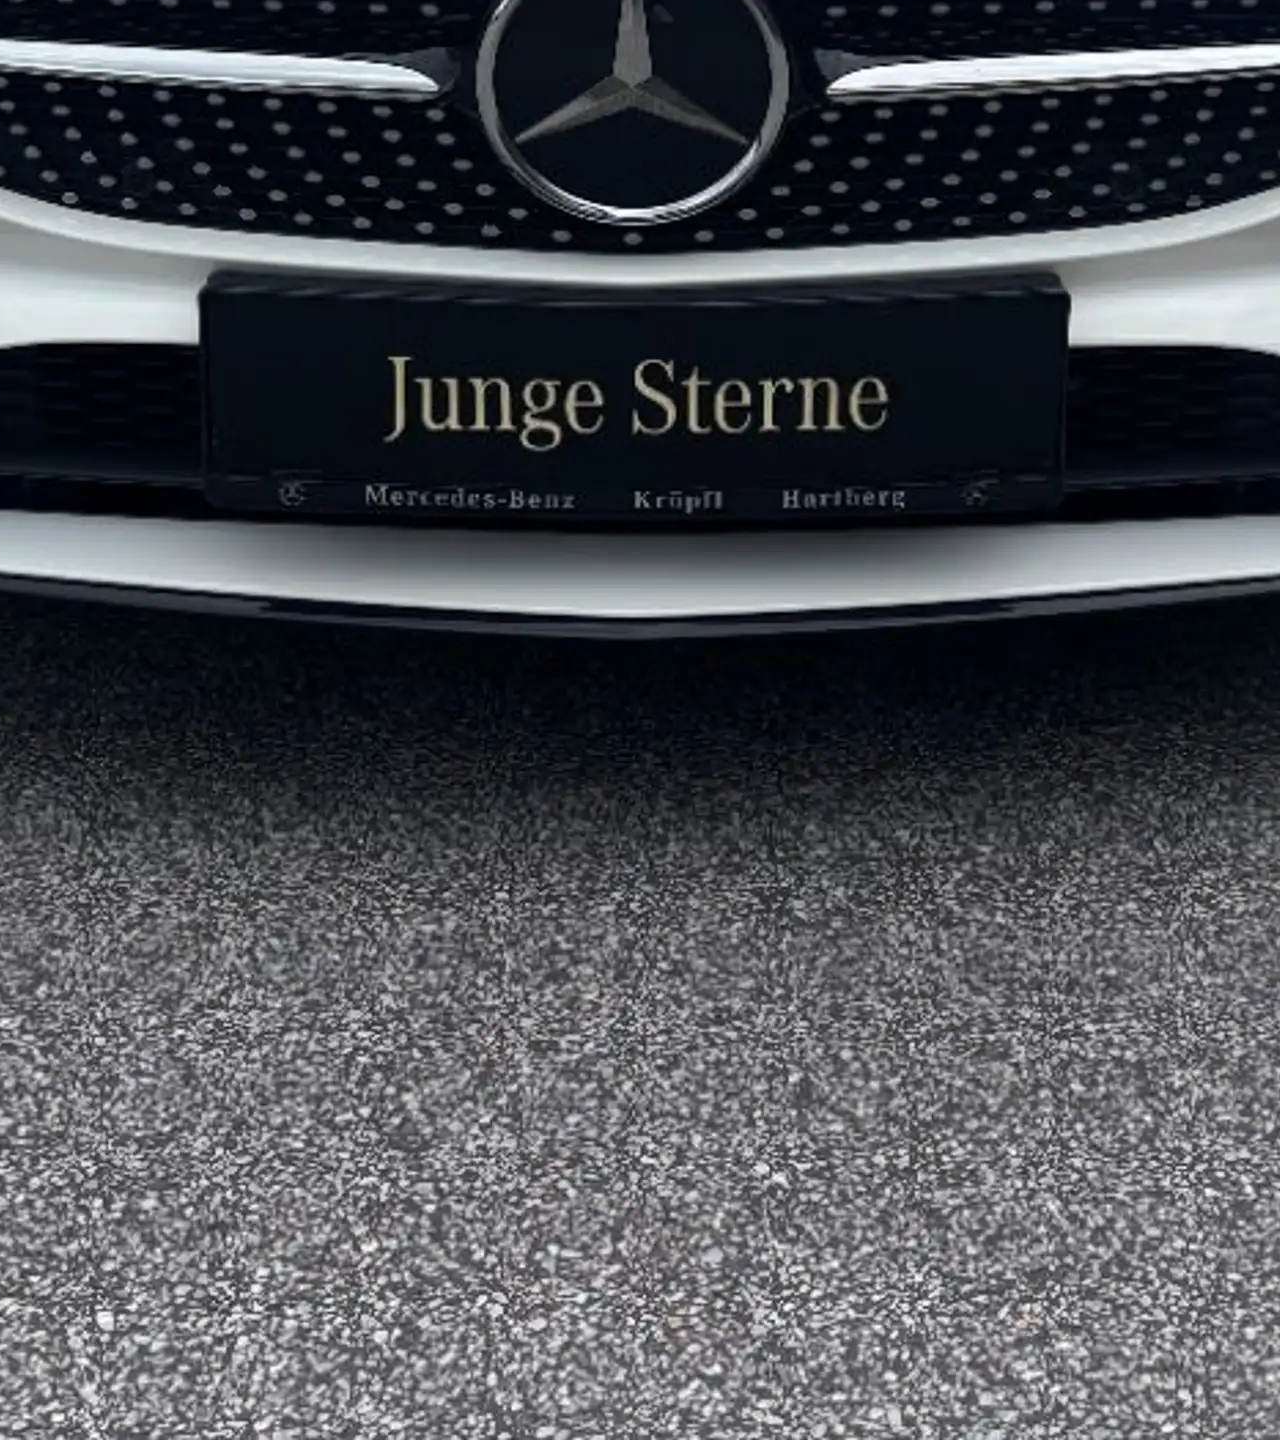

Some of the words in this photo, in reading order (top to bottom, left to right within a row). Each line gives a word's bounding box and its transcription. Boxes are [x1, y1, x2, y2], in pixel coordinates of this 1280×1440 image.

[383, 356, 604, 452] Junge
[632, 359, 890, 435] Sterne
[365, 484, 575, 509] Mercedes-Benz
[782, 488, 906, 510] Hartberg
